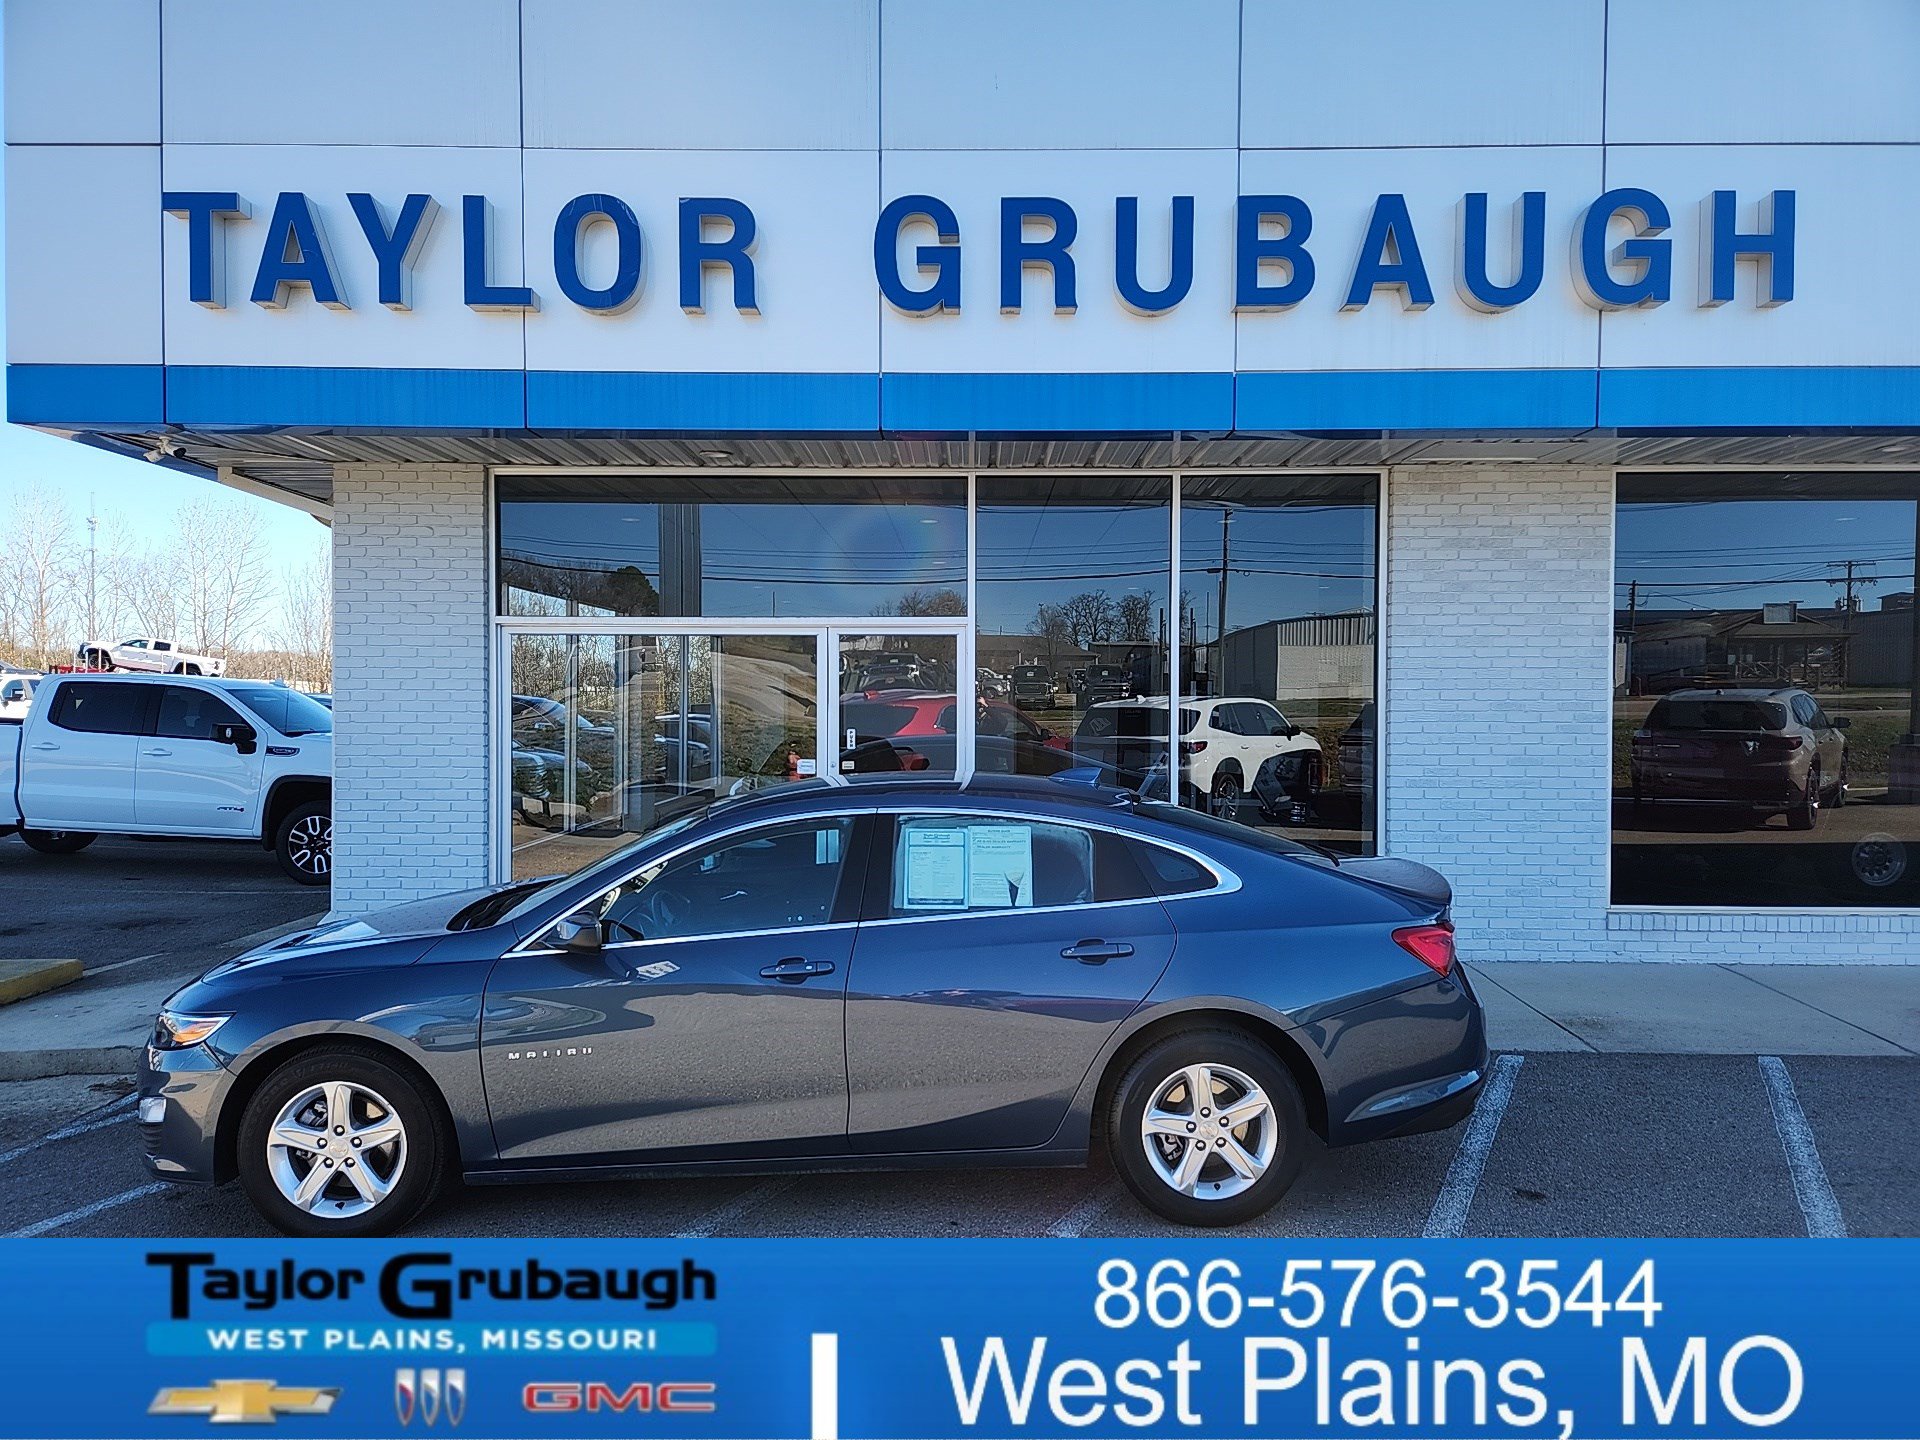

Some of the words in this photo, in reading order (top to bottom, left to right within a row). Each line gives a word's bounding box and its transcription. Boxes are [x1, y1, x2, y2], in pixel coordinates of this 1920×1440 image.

[162, 191, 760, 314] TAYLOR
[874, 187, 1796, 315] GRUBAUGH
[508, 1047, 593, 1060] MALIBU
